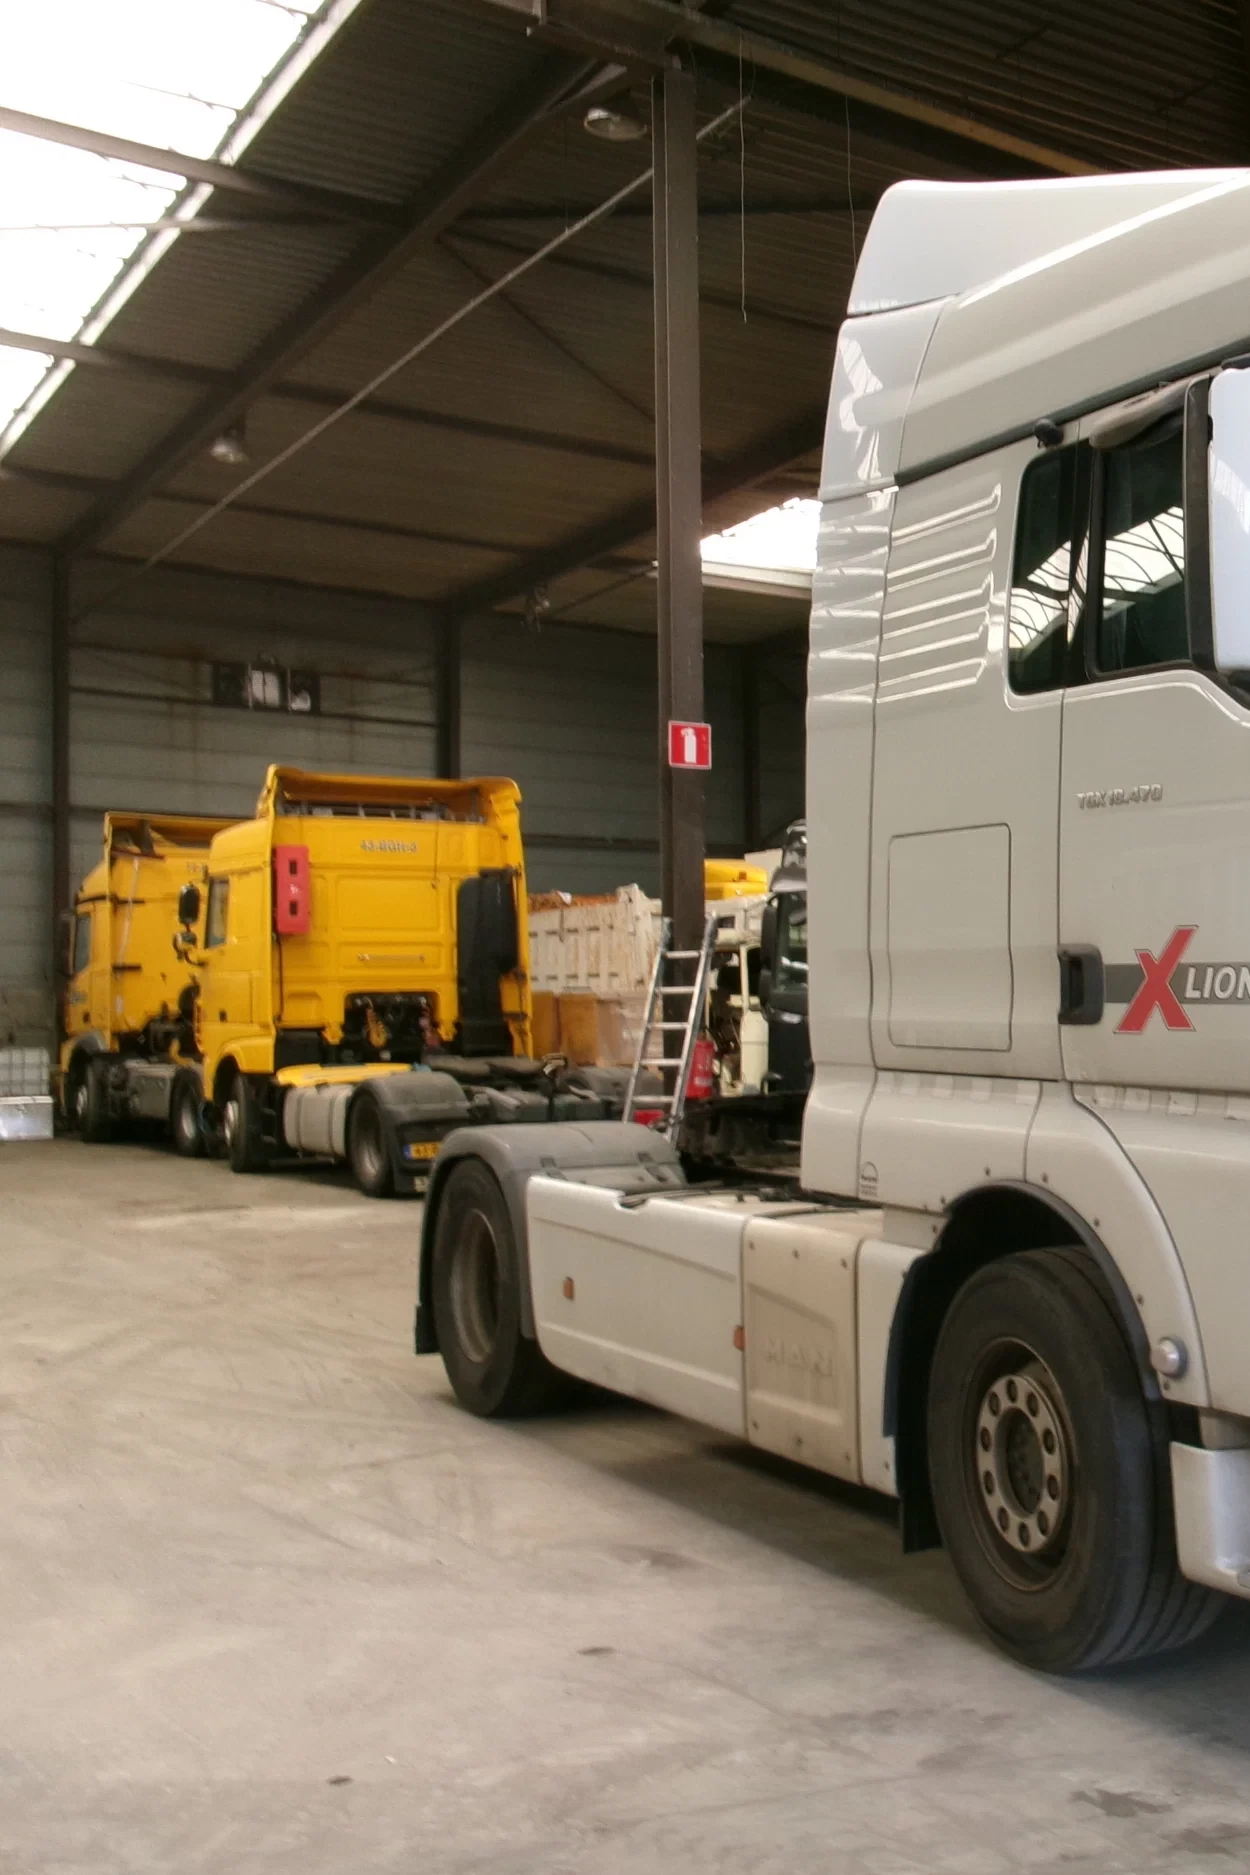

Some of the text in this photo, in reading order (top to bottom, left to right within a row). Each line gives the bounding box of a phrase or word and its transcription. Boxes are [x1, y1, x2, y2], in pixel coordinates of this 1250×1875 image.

[1076, 784, 1164, 810] TGX 18.470
[1113, 924, 1199, 1035] X
